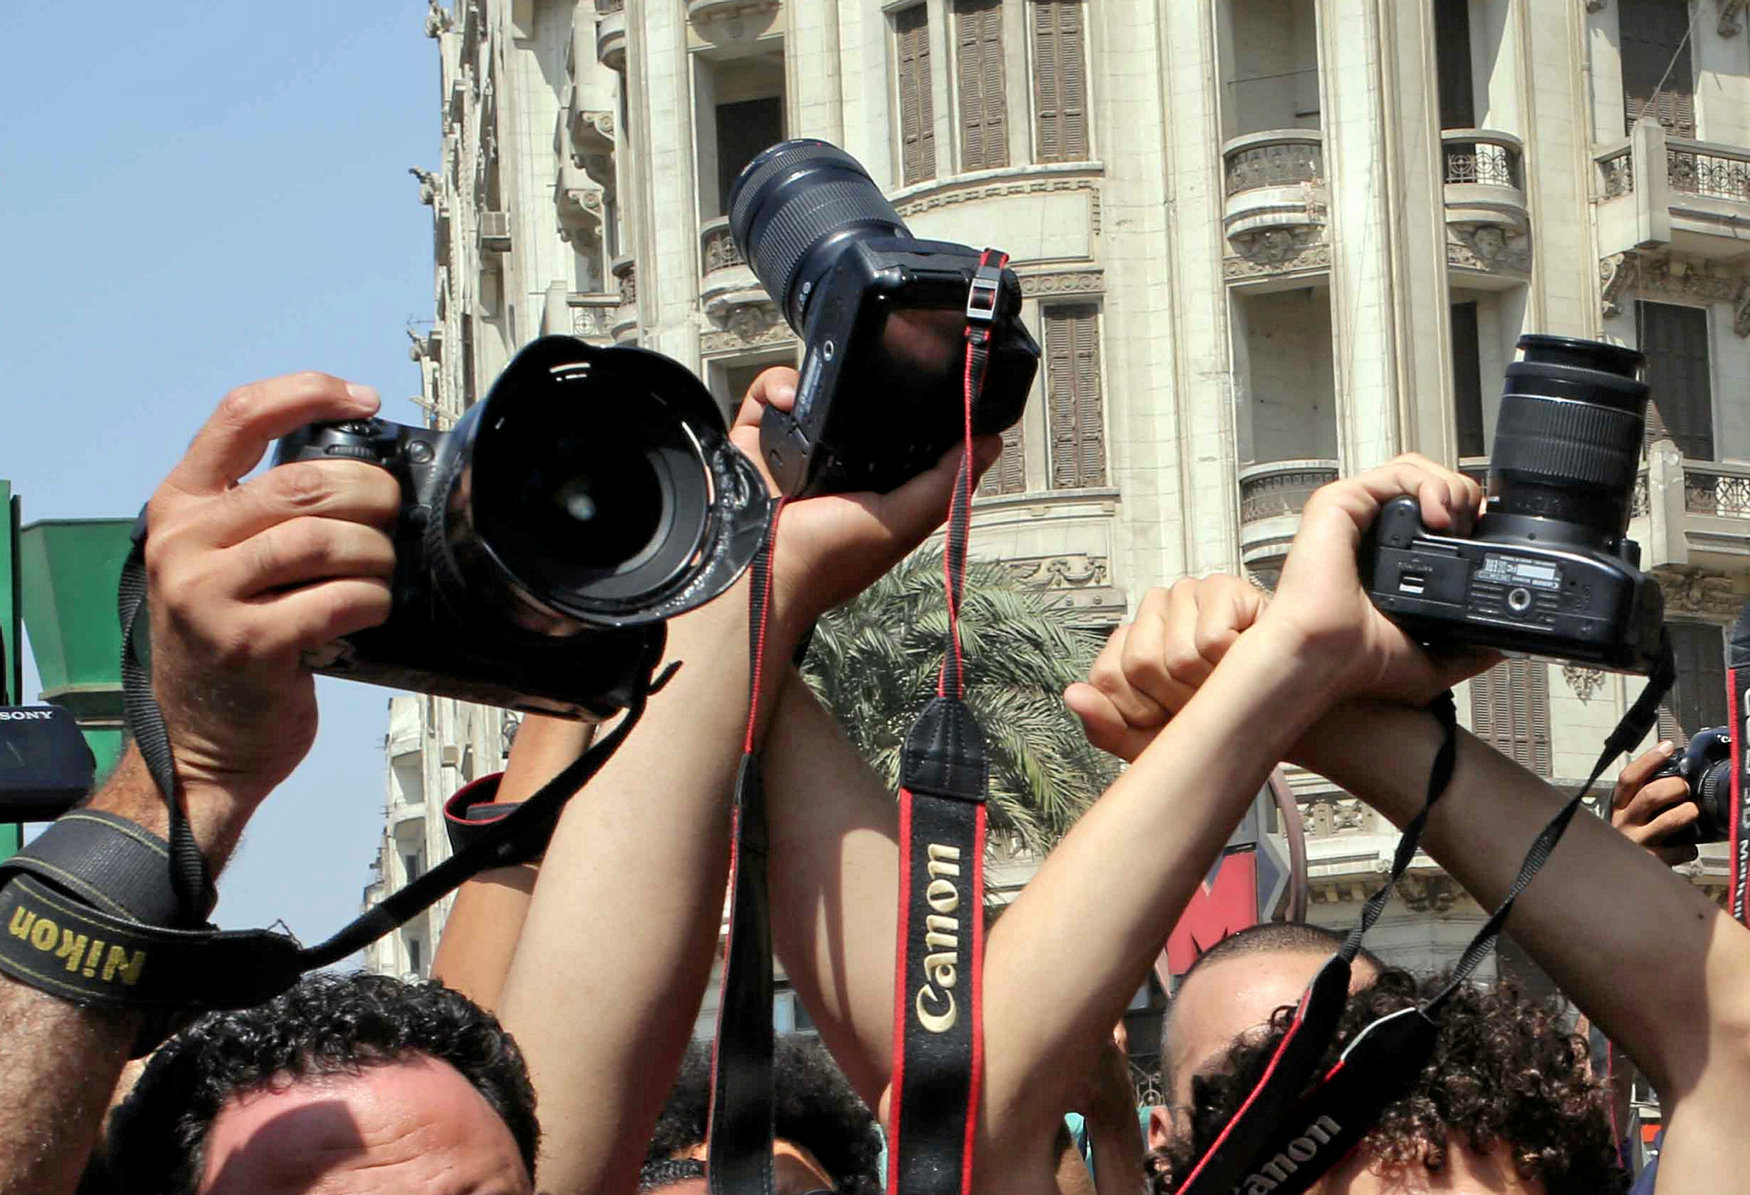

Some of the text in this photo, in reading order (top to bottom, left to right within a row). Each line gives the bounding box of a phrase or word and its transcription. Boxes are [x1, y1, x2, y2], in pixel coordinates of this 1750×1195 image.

[0, 710, 54, 720] SONY
[8, 905, 147, 985] Nikon
[916, 843, 960, 1033] Canon
